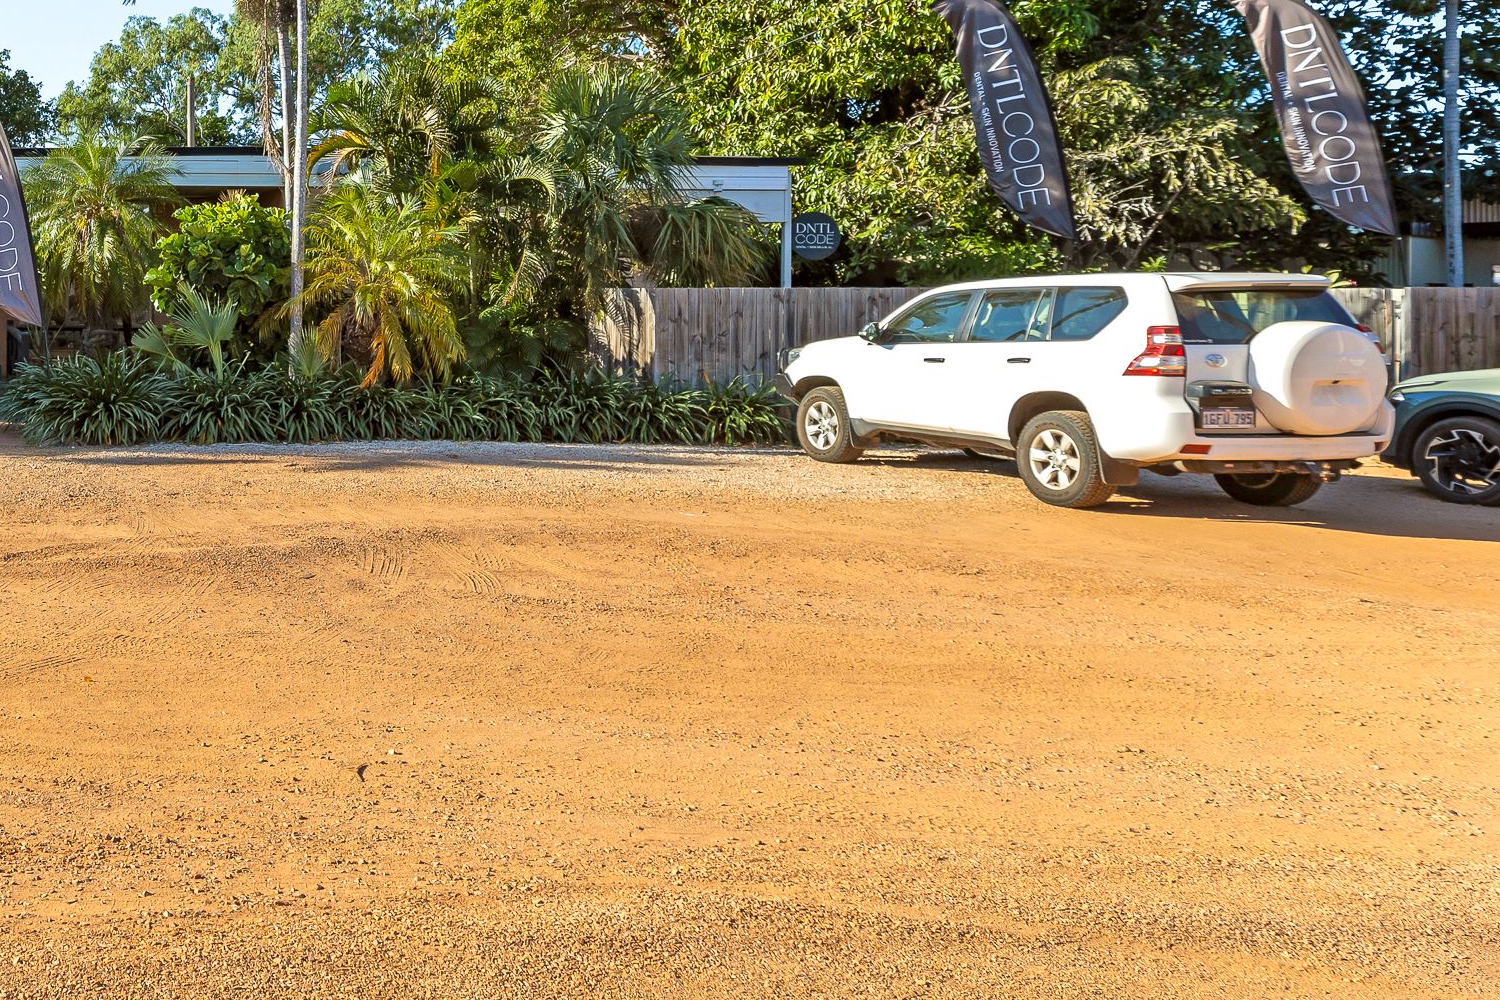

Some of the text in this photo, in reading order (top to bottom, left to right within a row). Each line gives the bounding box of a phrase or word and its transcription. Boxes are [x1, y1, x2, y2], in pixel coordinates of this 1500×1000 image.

[973, 71, 985, 101] DENTAL
[977, 23, 1051, 210] DNTLCODE
[981, 107, 993, 127] SKIN
[1280, 23, 1369, 207] DNTLCODE
[1288, 106, 1302, 127] SKIN
[986, 127, 1004, 173] INNOVATION
[1294, 127, 1316, 172] INNOVATION
[795, 233, 835, 245] CODE
[796, 222, 835, 234] DNTL
